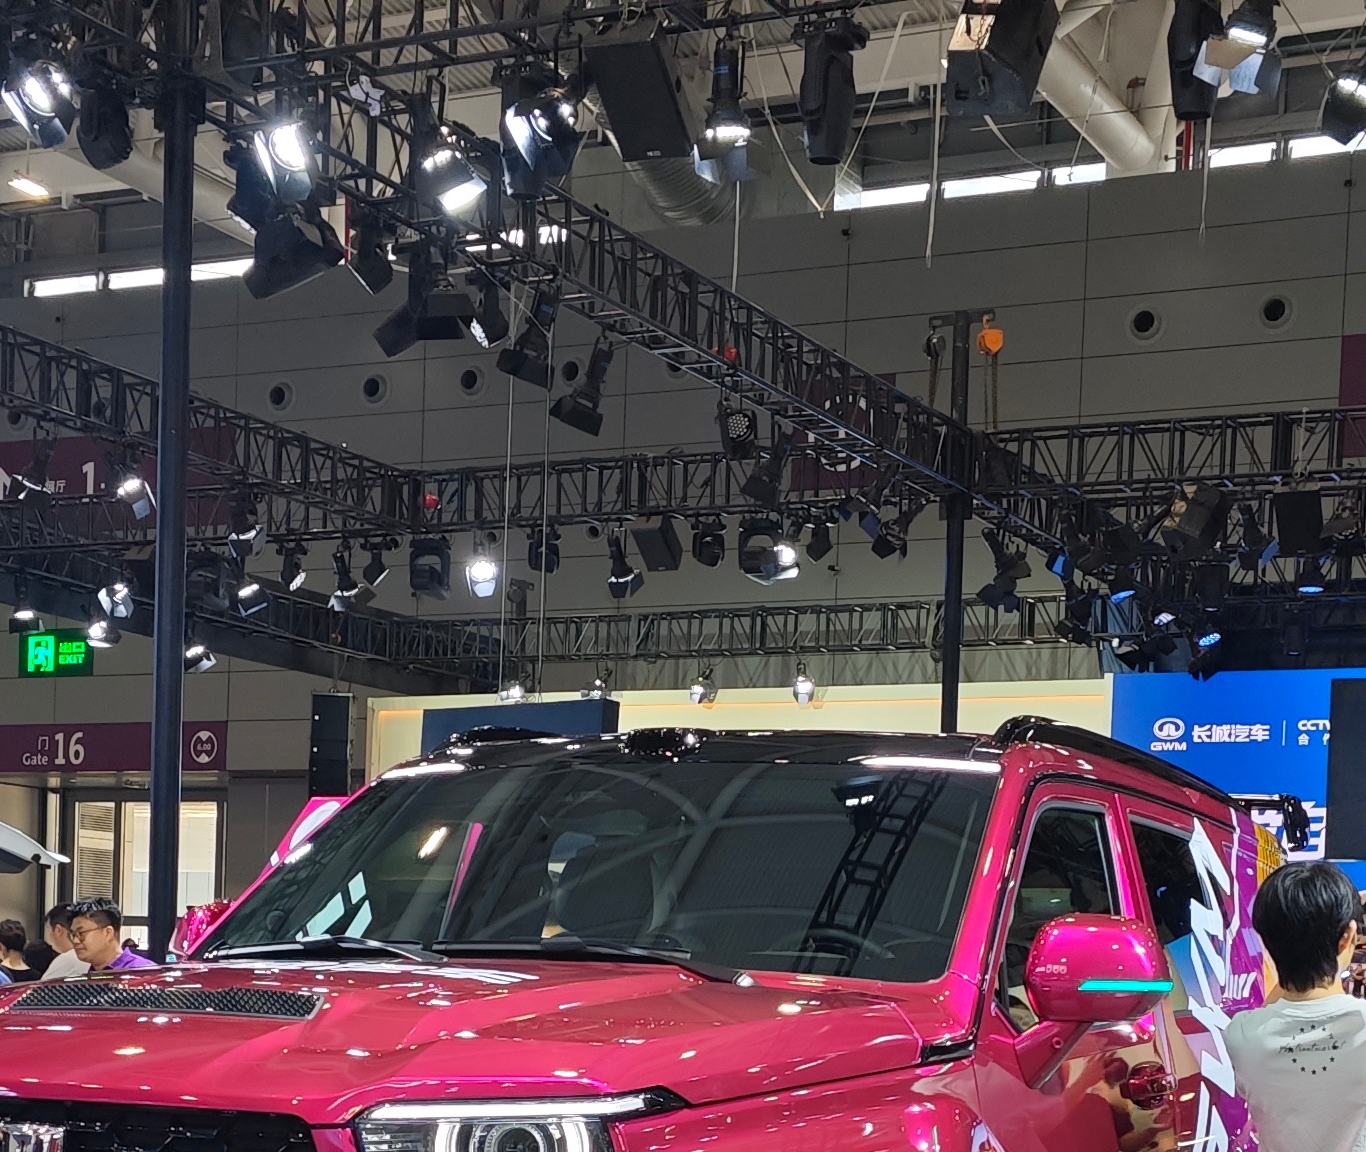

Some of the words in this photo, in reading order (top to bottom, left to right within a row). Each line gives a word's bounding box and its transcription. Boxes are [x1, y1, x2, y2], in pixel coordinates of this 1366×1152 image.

[59, 654, 85, 665] EXIT
[1192, 724, 1270, 743] 长城汽车
[22, 752, 49, 766] Gate
[54, 731, 85, 765] 16
[1150, 742, 1187, 751] GWM
